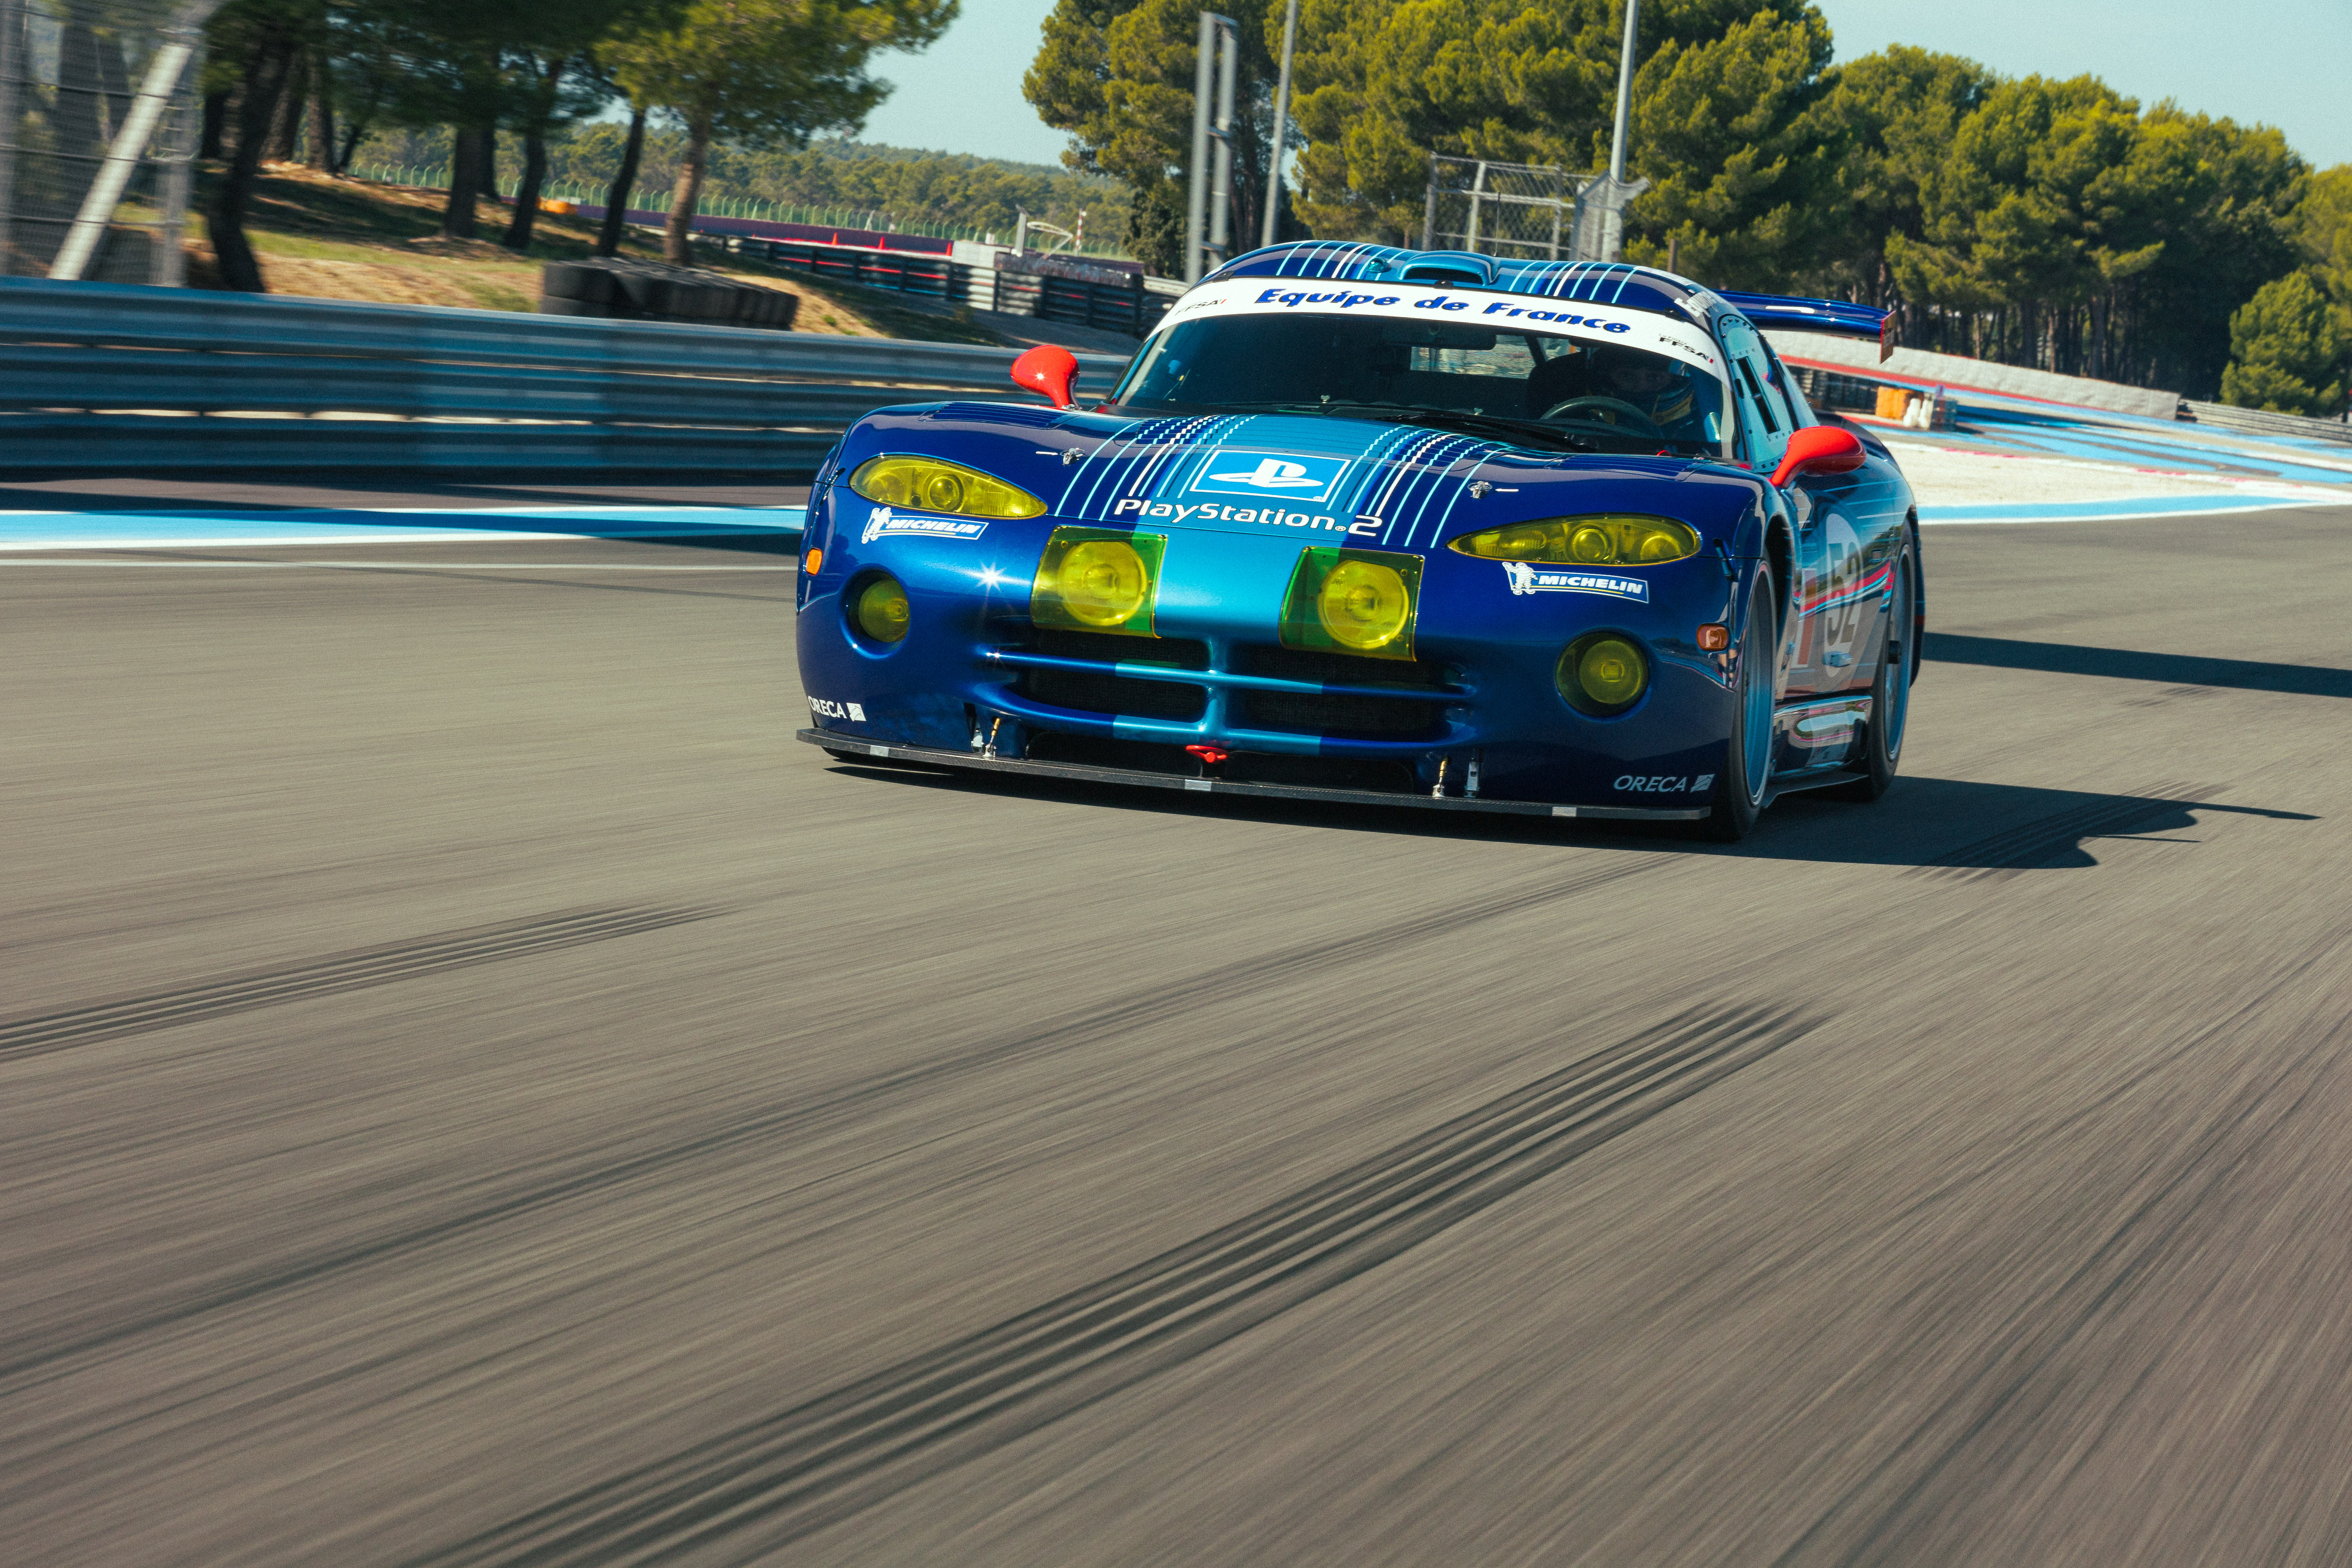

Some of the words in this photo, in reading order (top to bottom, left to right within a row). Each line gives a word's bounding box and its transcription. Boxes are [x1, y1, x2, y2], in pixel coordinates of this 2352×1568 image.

[1254, 289, 1401, 308] Equipe
[1414, 296, 1469, 310] de
[1482, 302, 1631, 333] France
[1659, 337, 1707, 361] FFSA
[885, 519, 981, 533] MICHELIN
[1114, 499, 1335, 531] PlayStation
[1538, 575, 1643, 594] MICHELIN
[808, 695, 847, 719] ORECA
[1613, 775, 1687, 792] ORECA
